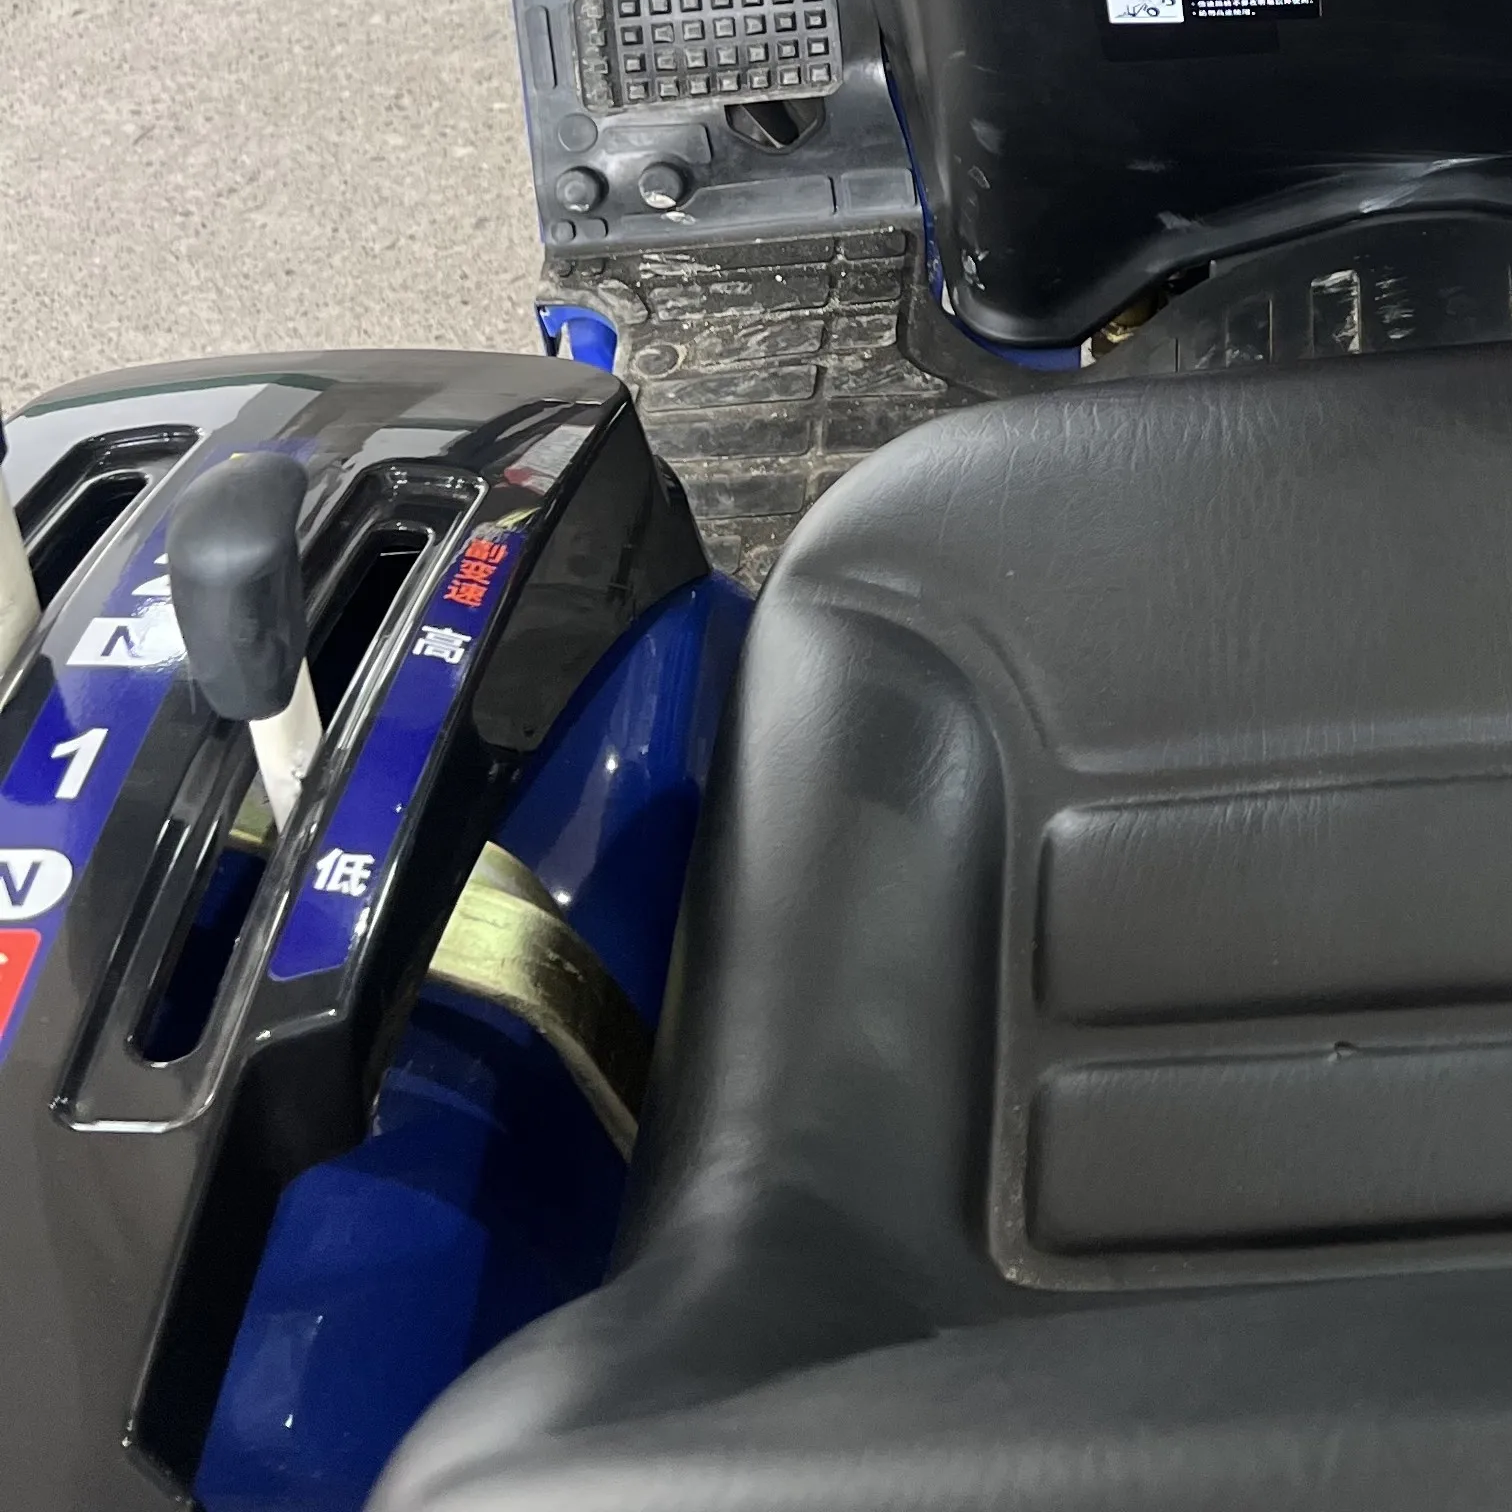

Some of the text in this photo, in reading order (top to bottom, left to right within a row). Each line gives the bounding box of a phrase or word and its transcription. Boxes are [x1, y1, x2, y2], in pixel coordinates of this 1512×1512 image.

[411, 623, 473, 665] 高
[51, 727, 109, 800] 1
[312, 847, 376, 898] 低
